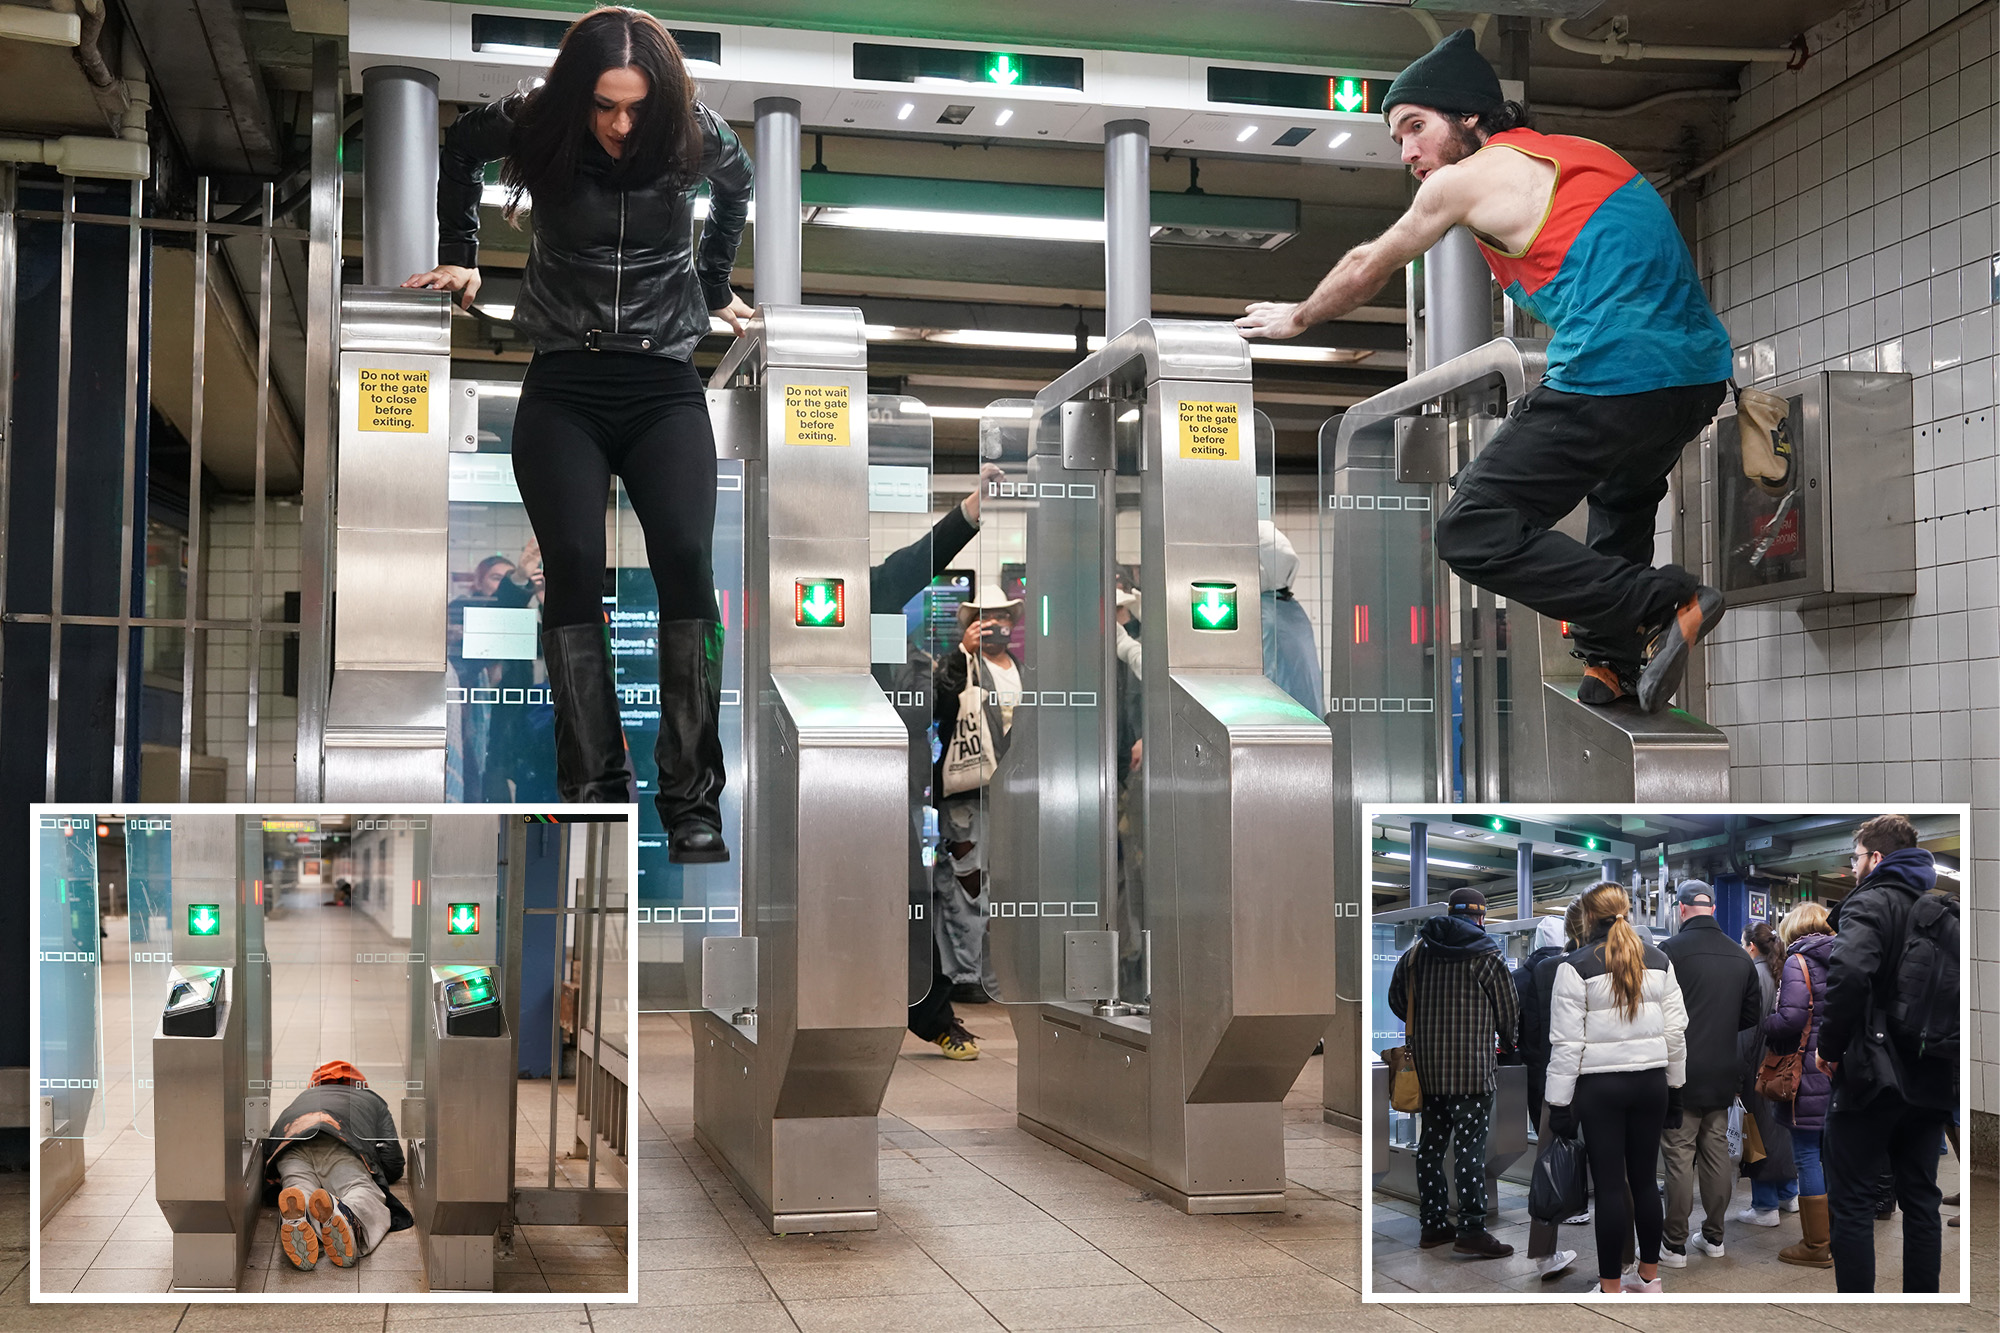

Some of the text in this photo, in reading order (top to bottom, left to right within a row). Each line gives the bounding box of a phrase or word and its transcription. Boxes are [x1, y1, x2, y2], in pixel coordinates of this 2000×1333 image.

[361, 370, 427, 382] Do not wait
[360, 382, 427, 395] for the gate
[786, 386, 847, 397] Do not wait
[371, 394, 417, 404] to close
[786, 398, 848, 409] for the gate
[375, 405, 413, 415] before
[1180, 402, 1237, 413] Do not wait
[796, 409, 838, 419] to close
[1180, 413, 1237, 425] for the gate
[373, 417, 415, 429] exiting.
[800, 420, 835, 429] before
[1189, 425, 1229, 434] to close
[798, 431, 837, 442] exiting.
[1193, 435, 1225, 444] before
[1191, 445, 1227, 457] exiting.
